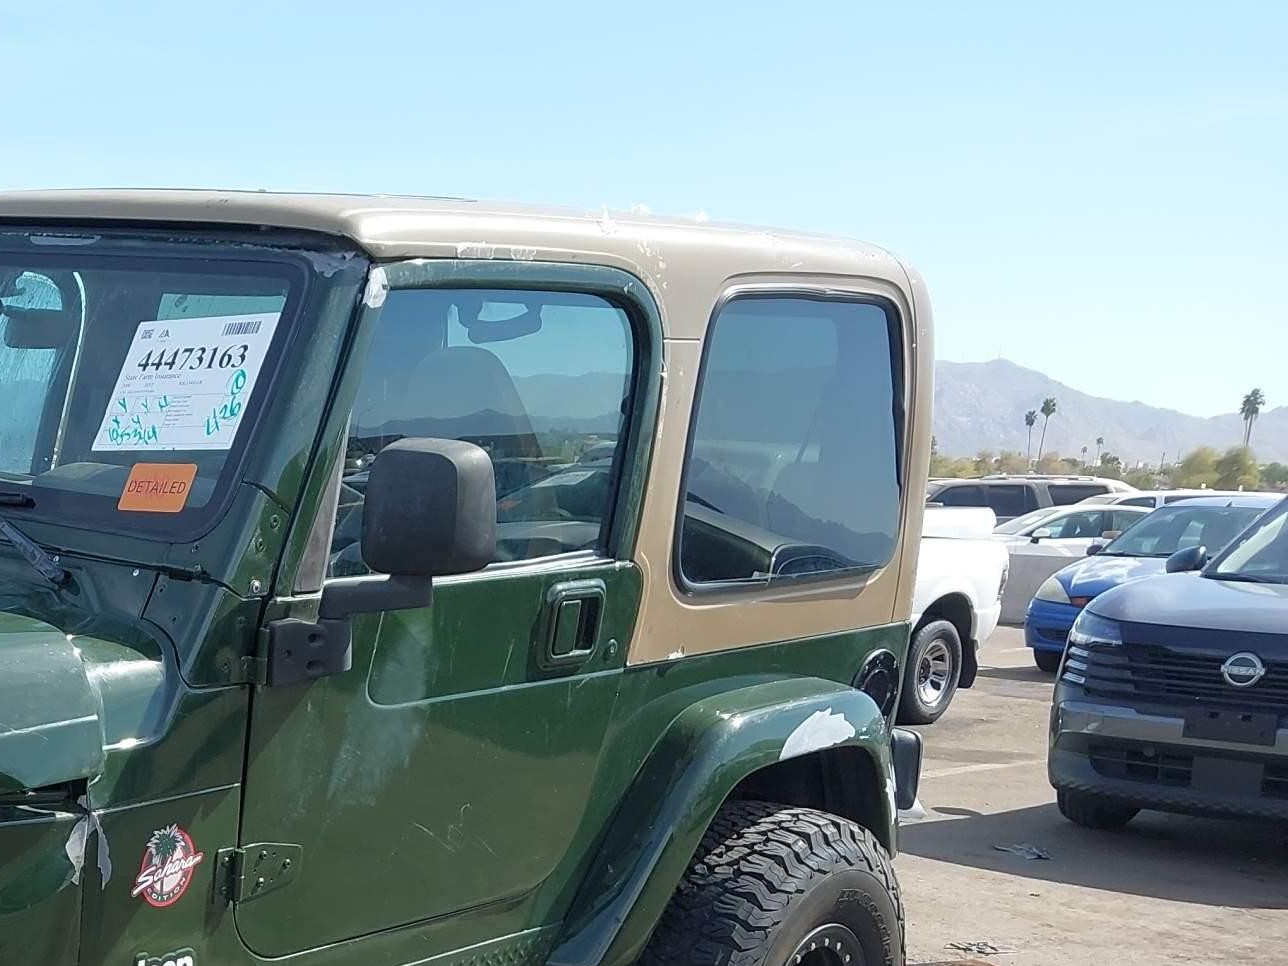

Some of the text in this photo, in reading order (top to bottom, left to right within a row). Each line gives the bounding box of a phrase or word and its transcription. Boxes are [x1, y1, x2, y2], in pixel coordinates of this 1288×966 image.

[137, 344, 249, 372] 44473163
[127, 480, 187, 494] DETAILED
[131, 853, 203, 897] Sahara
[147, 877, 186, 901] EDITION
